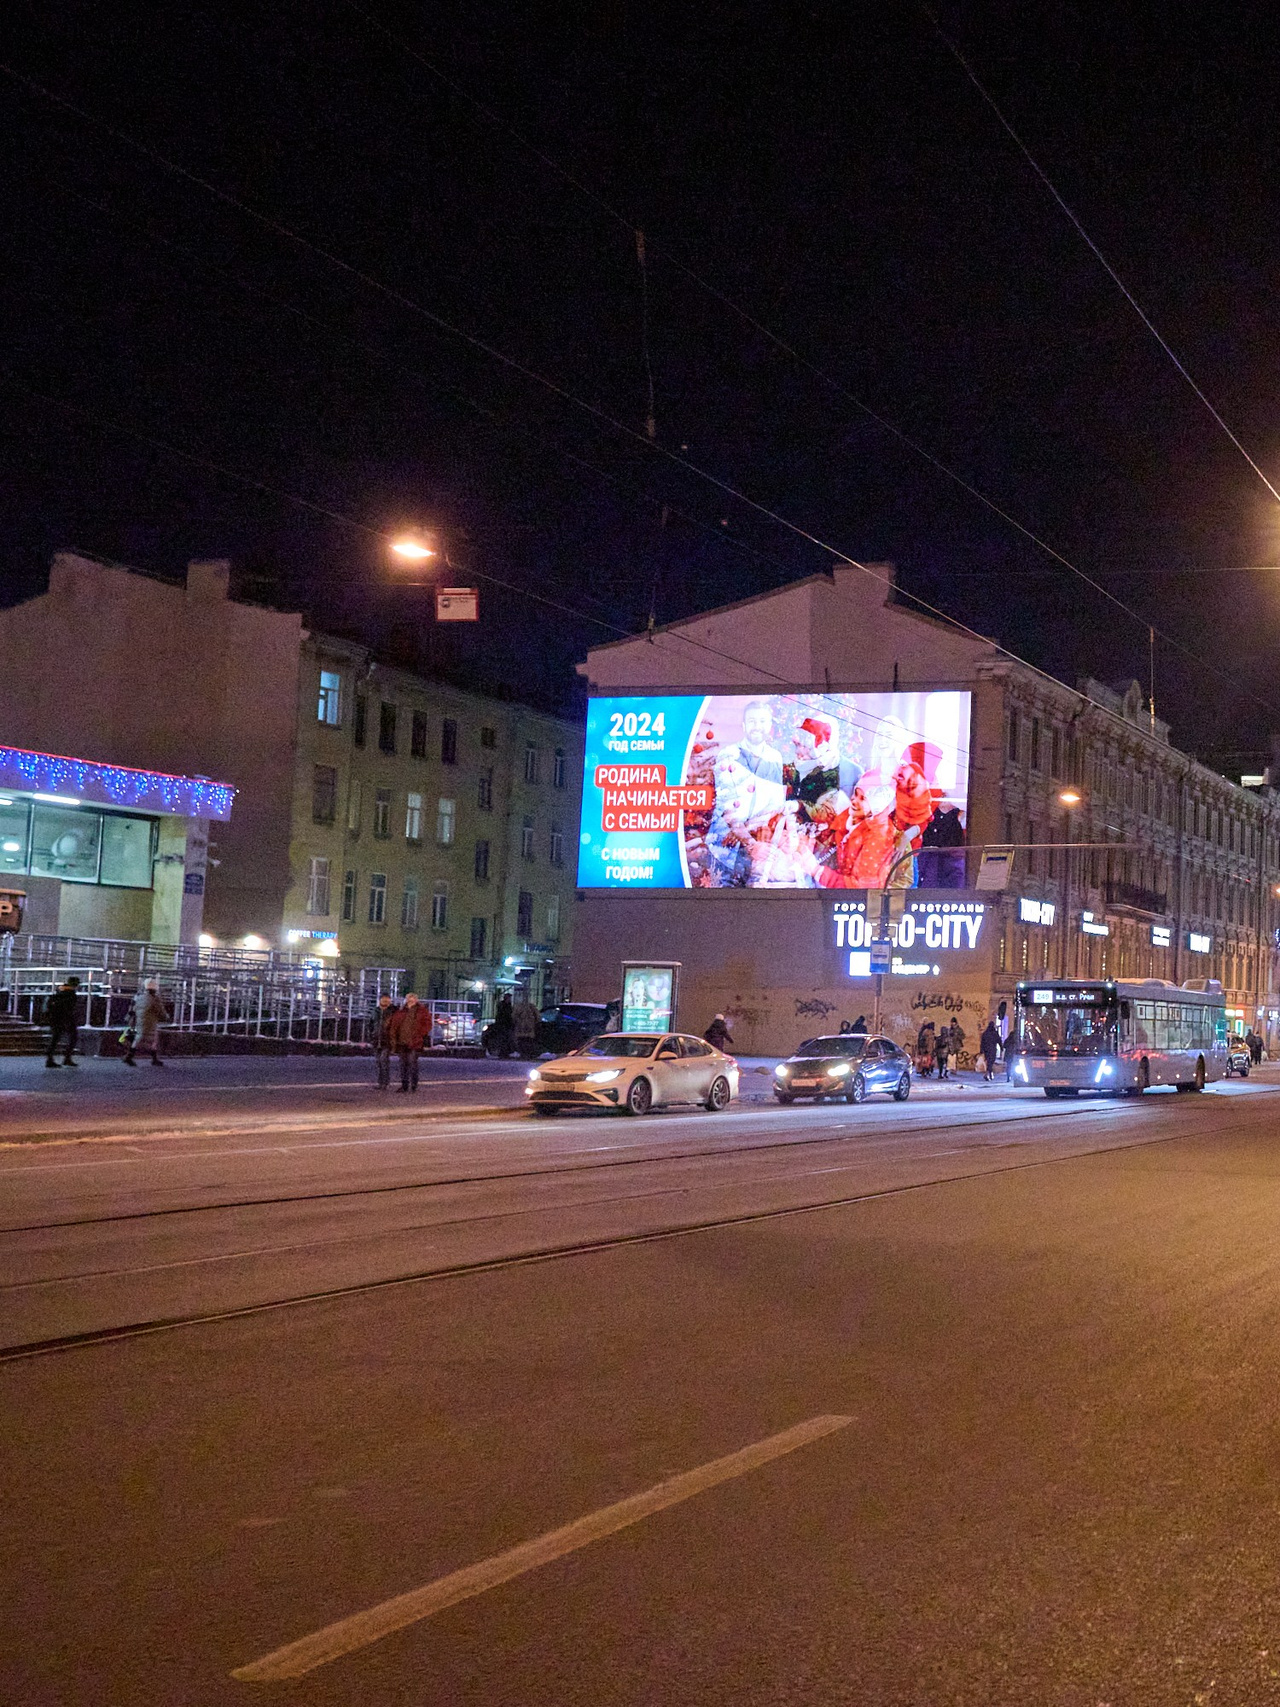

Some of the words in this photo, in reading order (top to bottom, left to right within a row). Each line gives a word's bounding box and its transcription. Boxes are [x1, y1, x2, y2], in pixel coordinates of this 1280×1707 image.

[609, 712, 665, 737] 2024
[609, 740, 628, 753] ГОД
[630, 740, 664, 751] СЕМЬИ
[598, 767, 661, 787] РОДИНА
[606, 790, 706, 806] НАЧИНАЕТСЯ
[605, 813, 615, 829] С
[619, 813, 675, 829] СЕМЬИ!
[601, 848, 611, 861] С
[612, 848, 660, 861] НОВЫМ
[605, 866, 654, 882] ГОДОМ!
